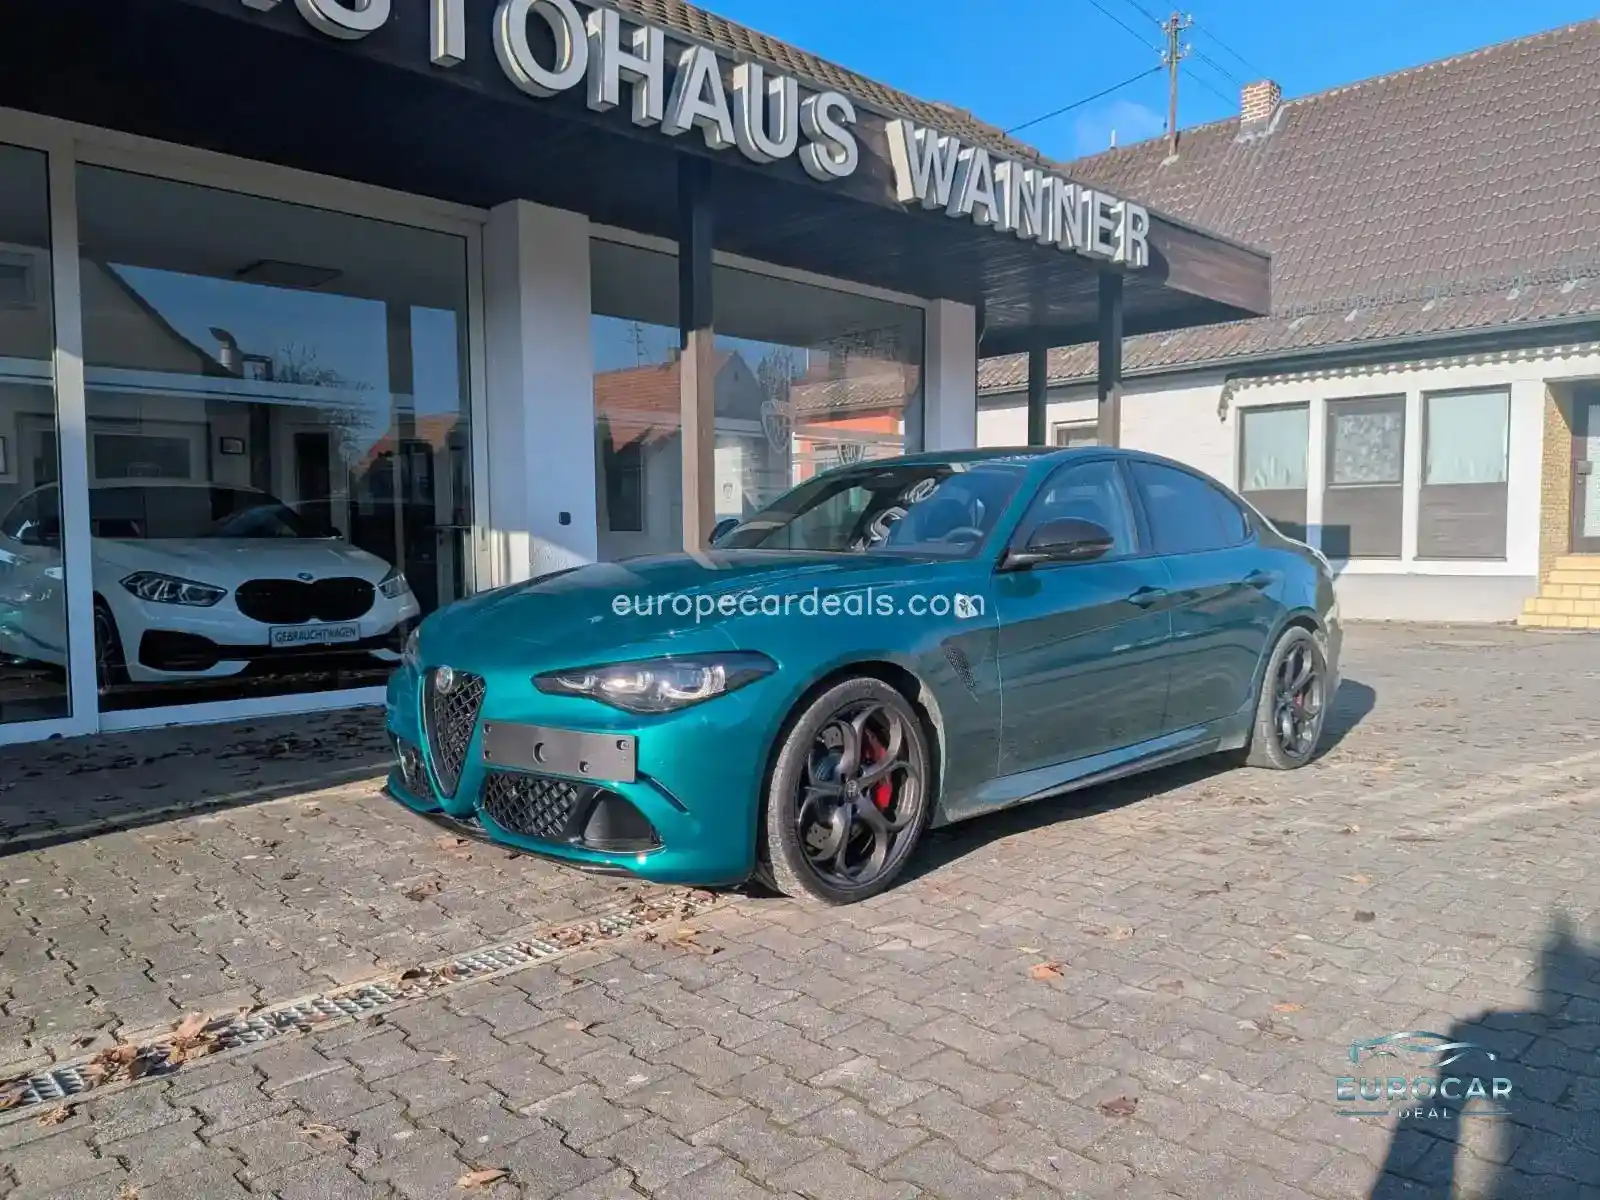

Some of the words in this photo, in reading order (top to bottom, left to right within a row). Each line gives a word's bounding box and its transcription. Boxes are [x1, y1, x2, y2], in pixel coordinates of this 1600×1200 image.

[240, 0, 858, 182] OHAUS
[886, 118, 1149, 268] WANNER
[274, 627, 356, 643] GEBRAUCHTWAGEN
